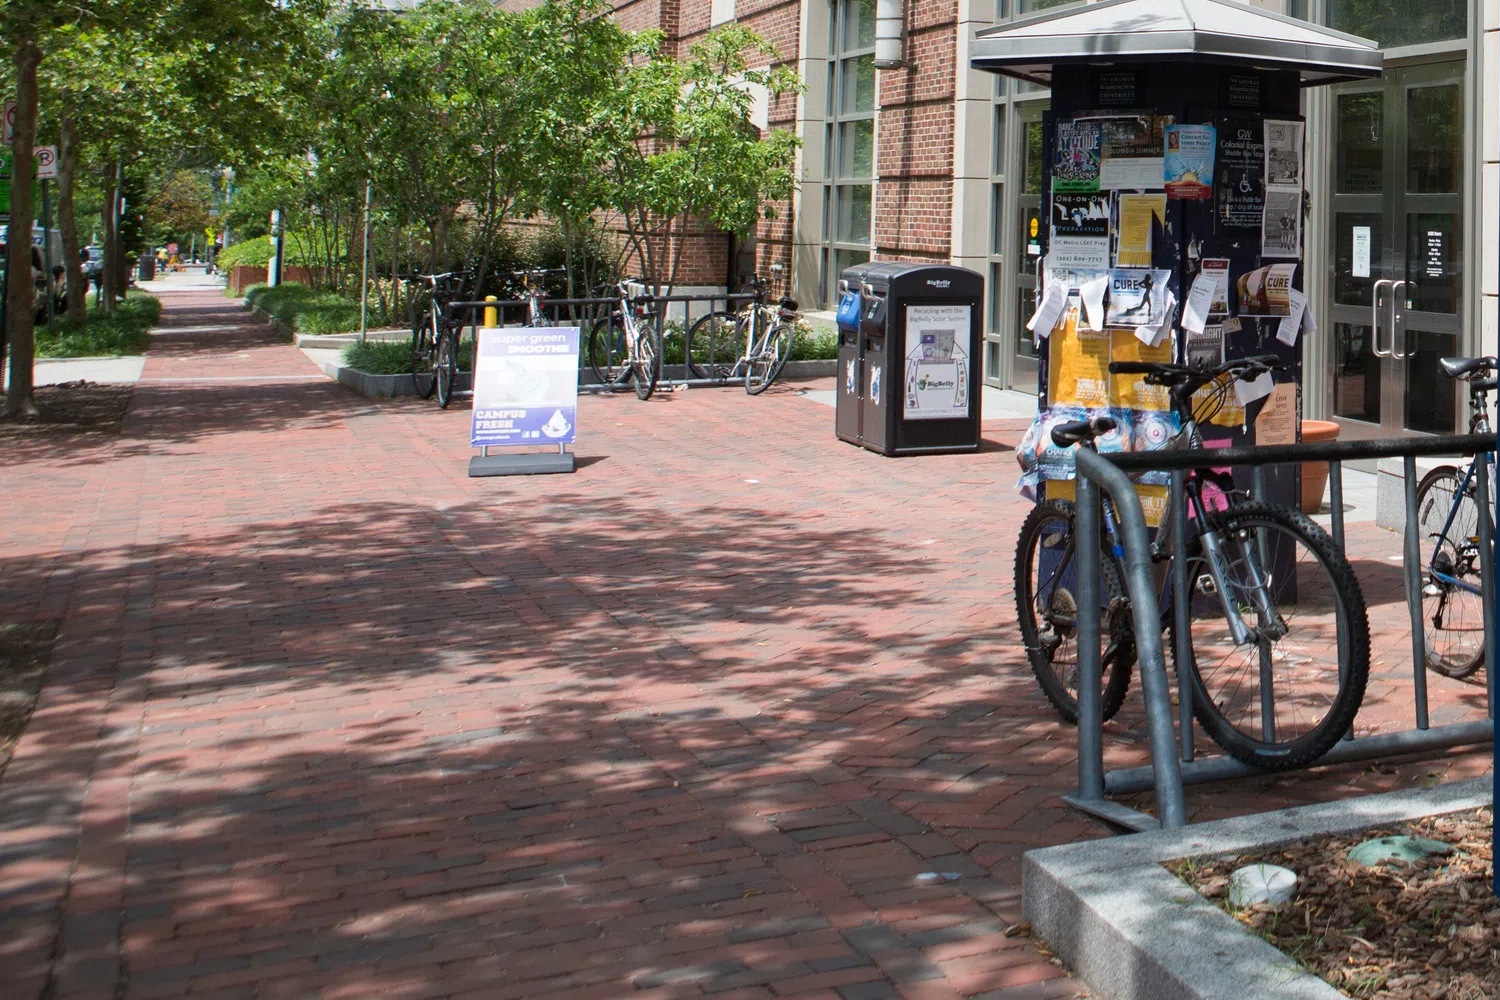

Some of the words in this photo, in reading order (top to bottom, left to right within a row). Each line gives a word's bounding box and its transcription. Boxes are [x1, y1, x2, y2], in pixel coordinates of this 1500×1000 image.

[1237, 129, 1252, 138] GW
[1058, 135, 1099, 152] ATTITUDE
[1220, 141, 1245, 149] Colonial
[1247, 142, 1264, 151] Expre
[1113, 279, 1139, 290] CURE
[1267, 277, 1289, 288] CURE
[914, 307, 939, 316] Recycling
[909, 315, 931, 323] BigBelly
[492, 334, 528, 344] super
[530, 334, 566, 344] green
[475, 409, 527, 419] CAMPUS
[475, 419, 514, 429] FRESH
[1046, 448, 1073, 457] CHANGE
